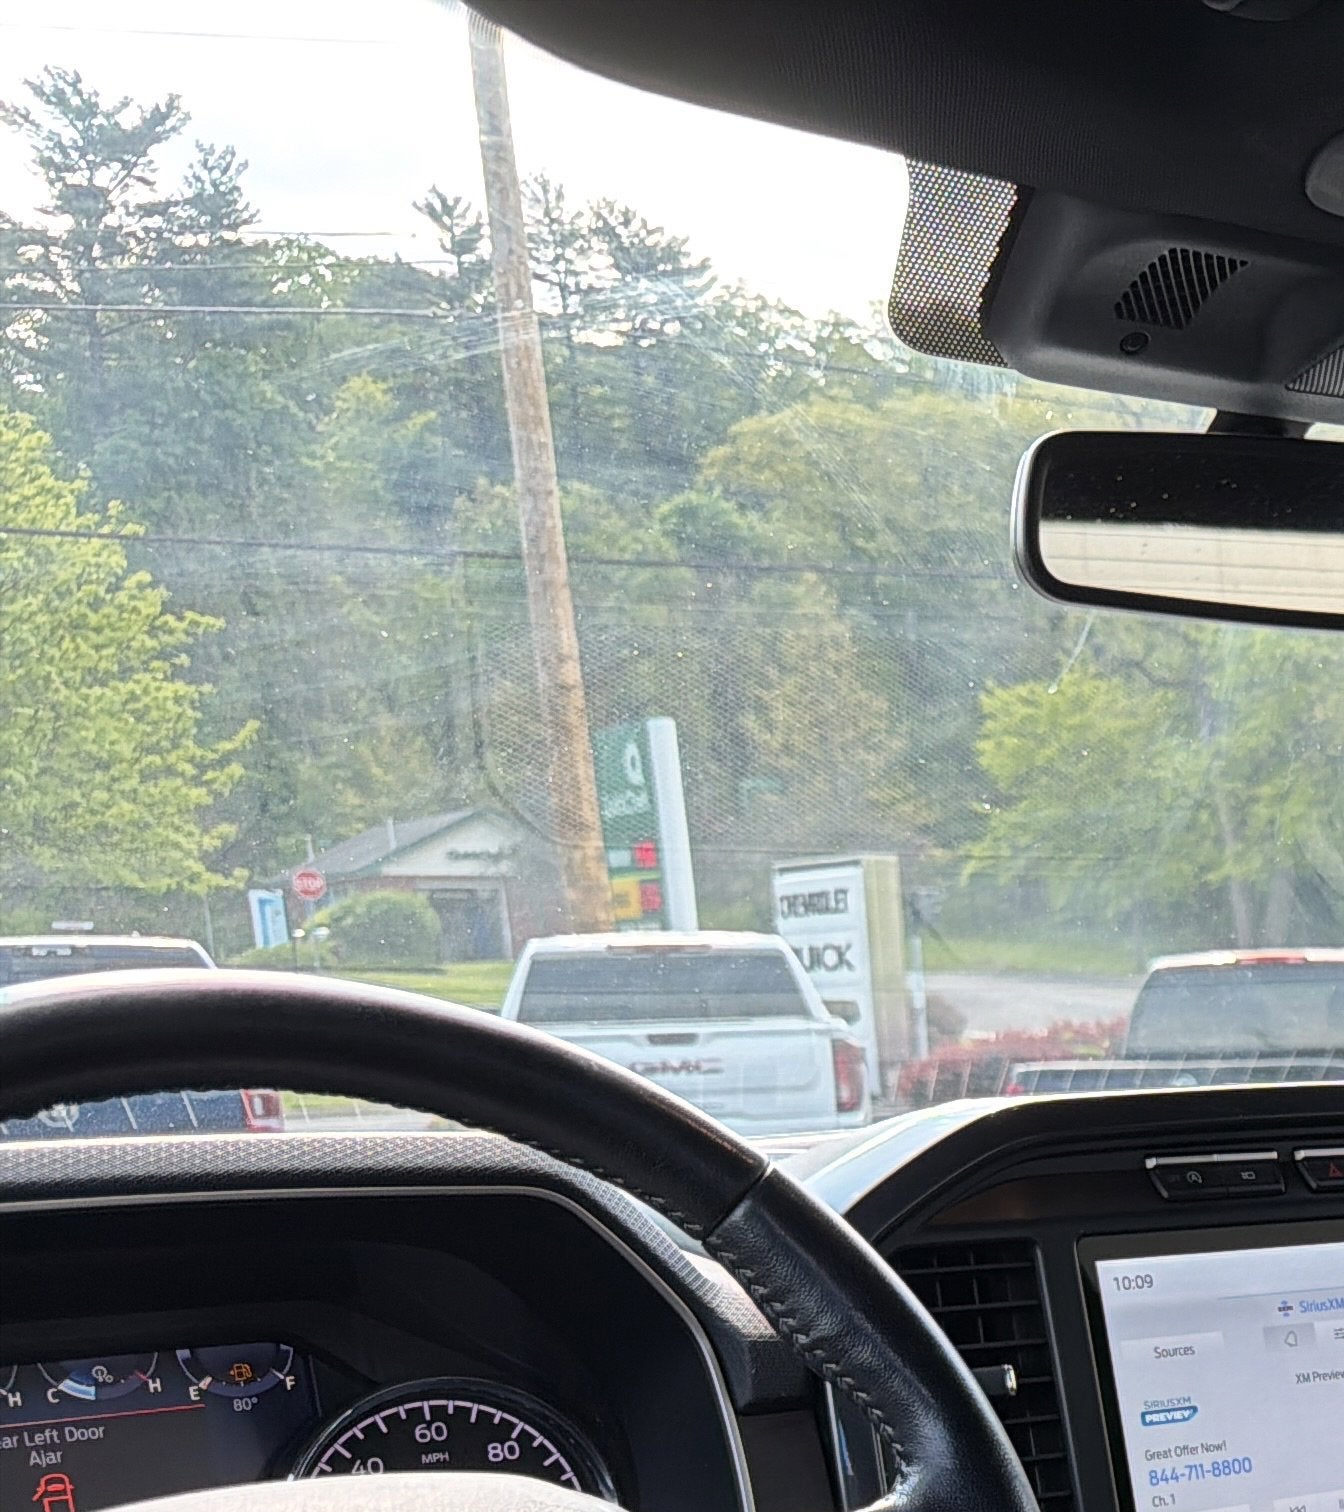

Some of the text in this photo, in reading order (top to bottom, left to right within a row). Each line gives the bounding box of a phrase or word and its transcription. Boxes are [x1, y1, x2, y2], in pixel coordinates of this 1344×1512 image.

[791, 943, 855, 972] UICK
[1113, 1274, 1154, 1291] 10:09
[1154, 1345, 1195, 1359] Sources
[148, 1378, 162, 1393] H
[285, 1376, 295, 1390] F
[1295, 1373, 1311, 1384] XM
[8, 1392, 22, 1407] H
[46, 1388, 59, 1403] C
[189, 1386, 200, 1401] E
[1143, 1396, 1191, 1410] SIRIUSXM
[1145, 1409, 1191, 1424] PREVIEW
[23, 1428, 60, 1447] Left
[64, 1426, 104, 1442] Door
[414, 1422, 447, 1443] 60
[421, 1452, 449, 1464] MPH
[487, 1440, 520, 1462] 80
[1145, 1440, 1227, 1461] Great Offer Now!
[29, 1450, 62, 1468] Ajar
[351, 1457, 384, 1475] 40
[1149, 1456, 1253, 1486] 844-711-8800
[1152, 1495, 1169, 1508] Ch.
